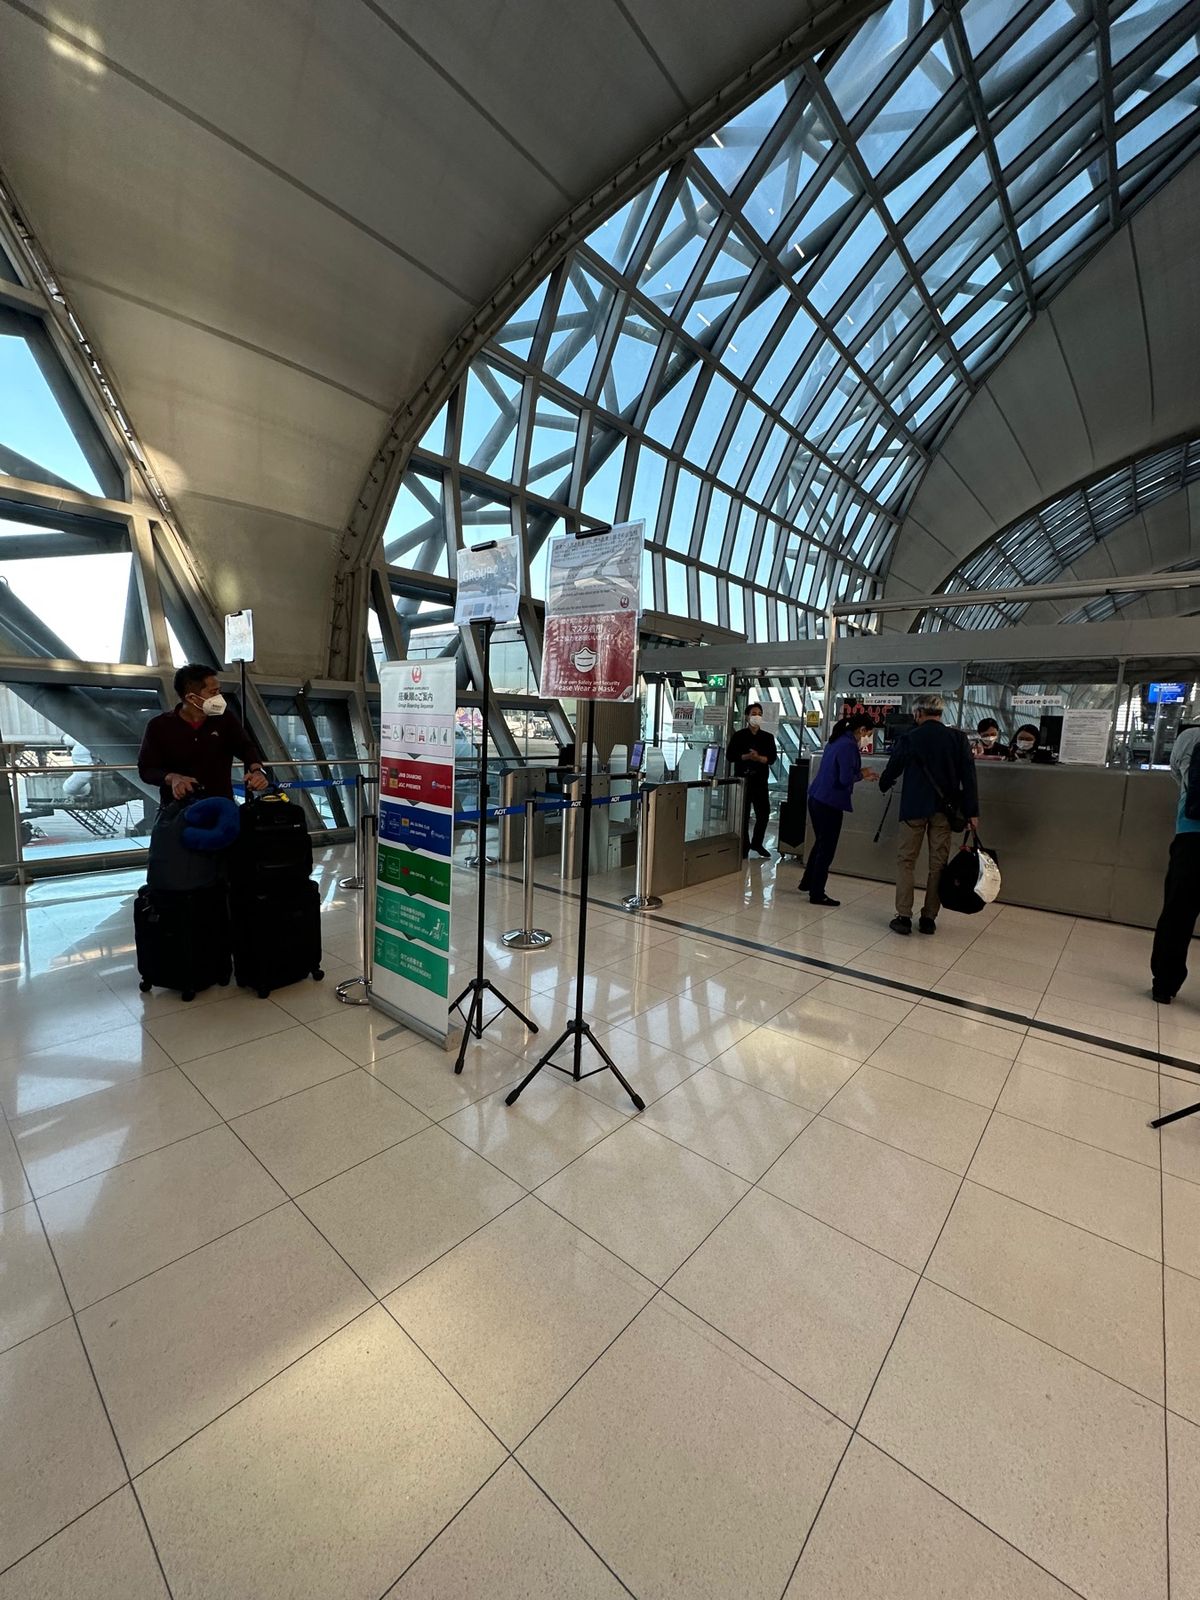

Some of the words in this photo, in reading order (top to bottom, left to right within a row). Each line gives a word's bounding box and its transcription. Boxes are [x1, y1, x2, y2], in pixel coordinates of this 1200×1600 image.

[463, 565, 492, 582] GROUP
[848, 669, 900, 688] Gate
[908, 668, 944, 688] G2
[574, 685, 591, 693] Wear
[598, 685, 617, 693] Mask.
